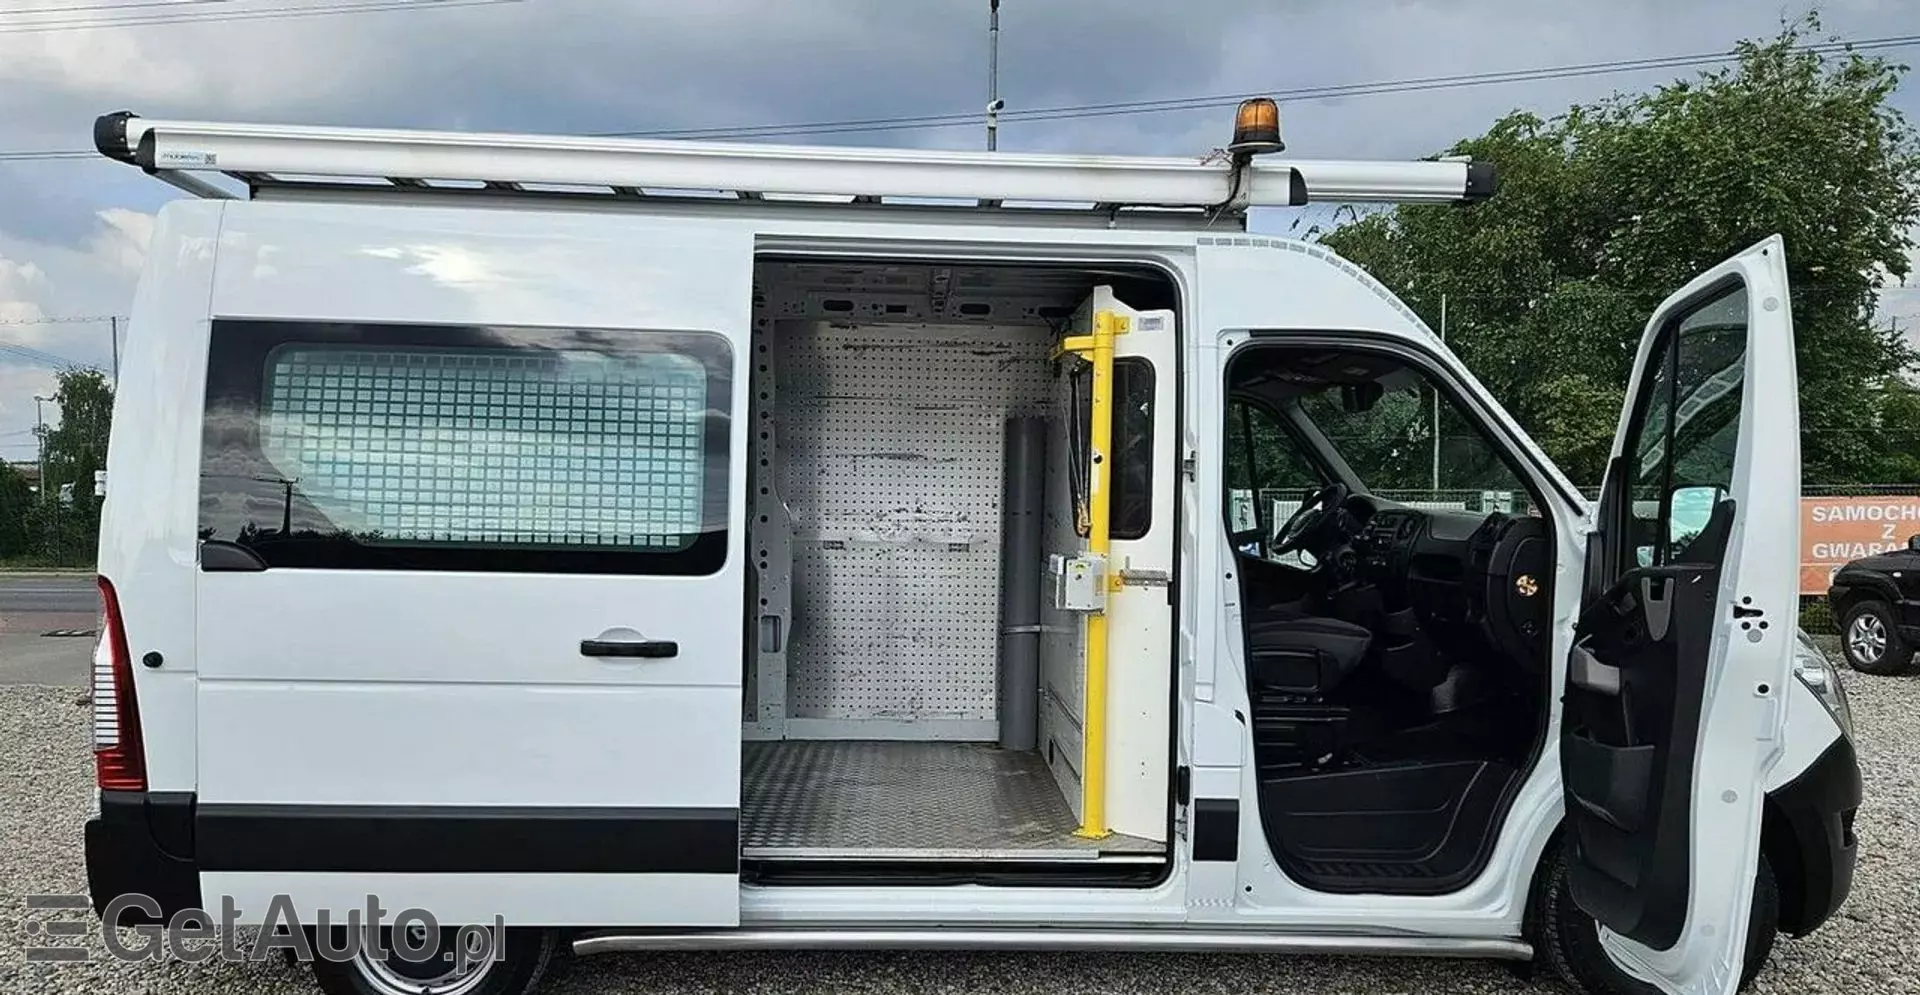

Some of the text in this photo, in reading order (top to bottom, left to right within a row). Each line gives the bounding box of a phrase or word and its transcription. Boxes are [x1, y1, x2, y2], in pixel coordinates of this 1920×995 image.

[1812, 505, 1920, 521] SAMOCH
[1881, 523, 1896, 539] Z
[1812, 542, 1908, 559] GWARA
